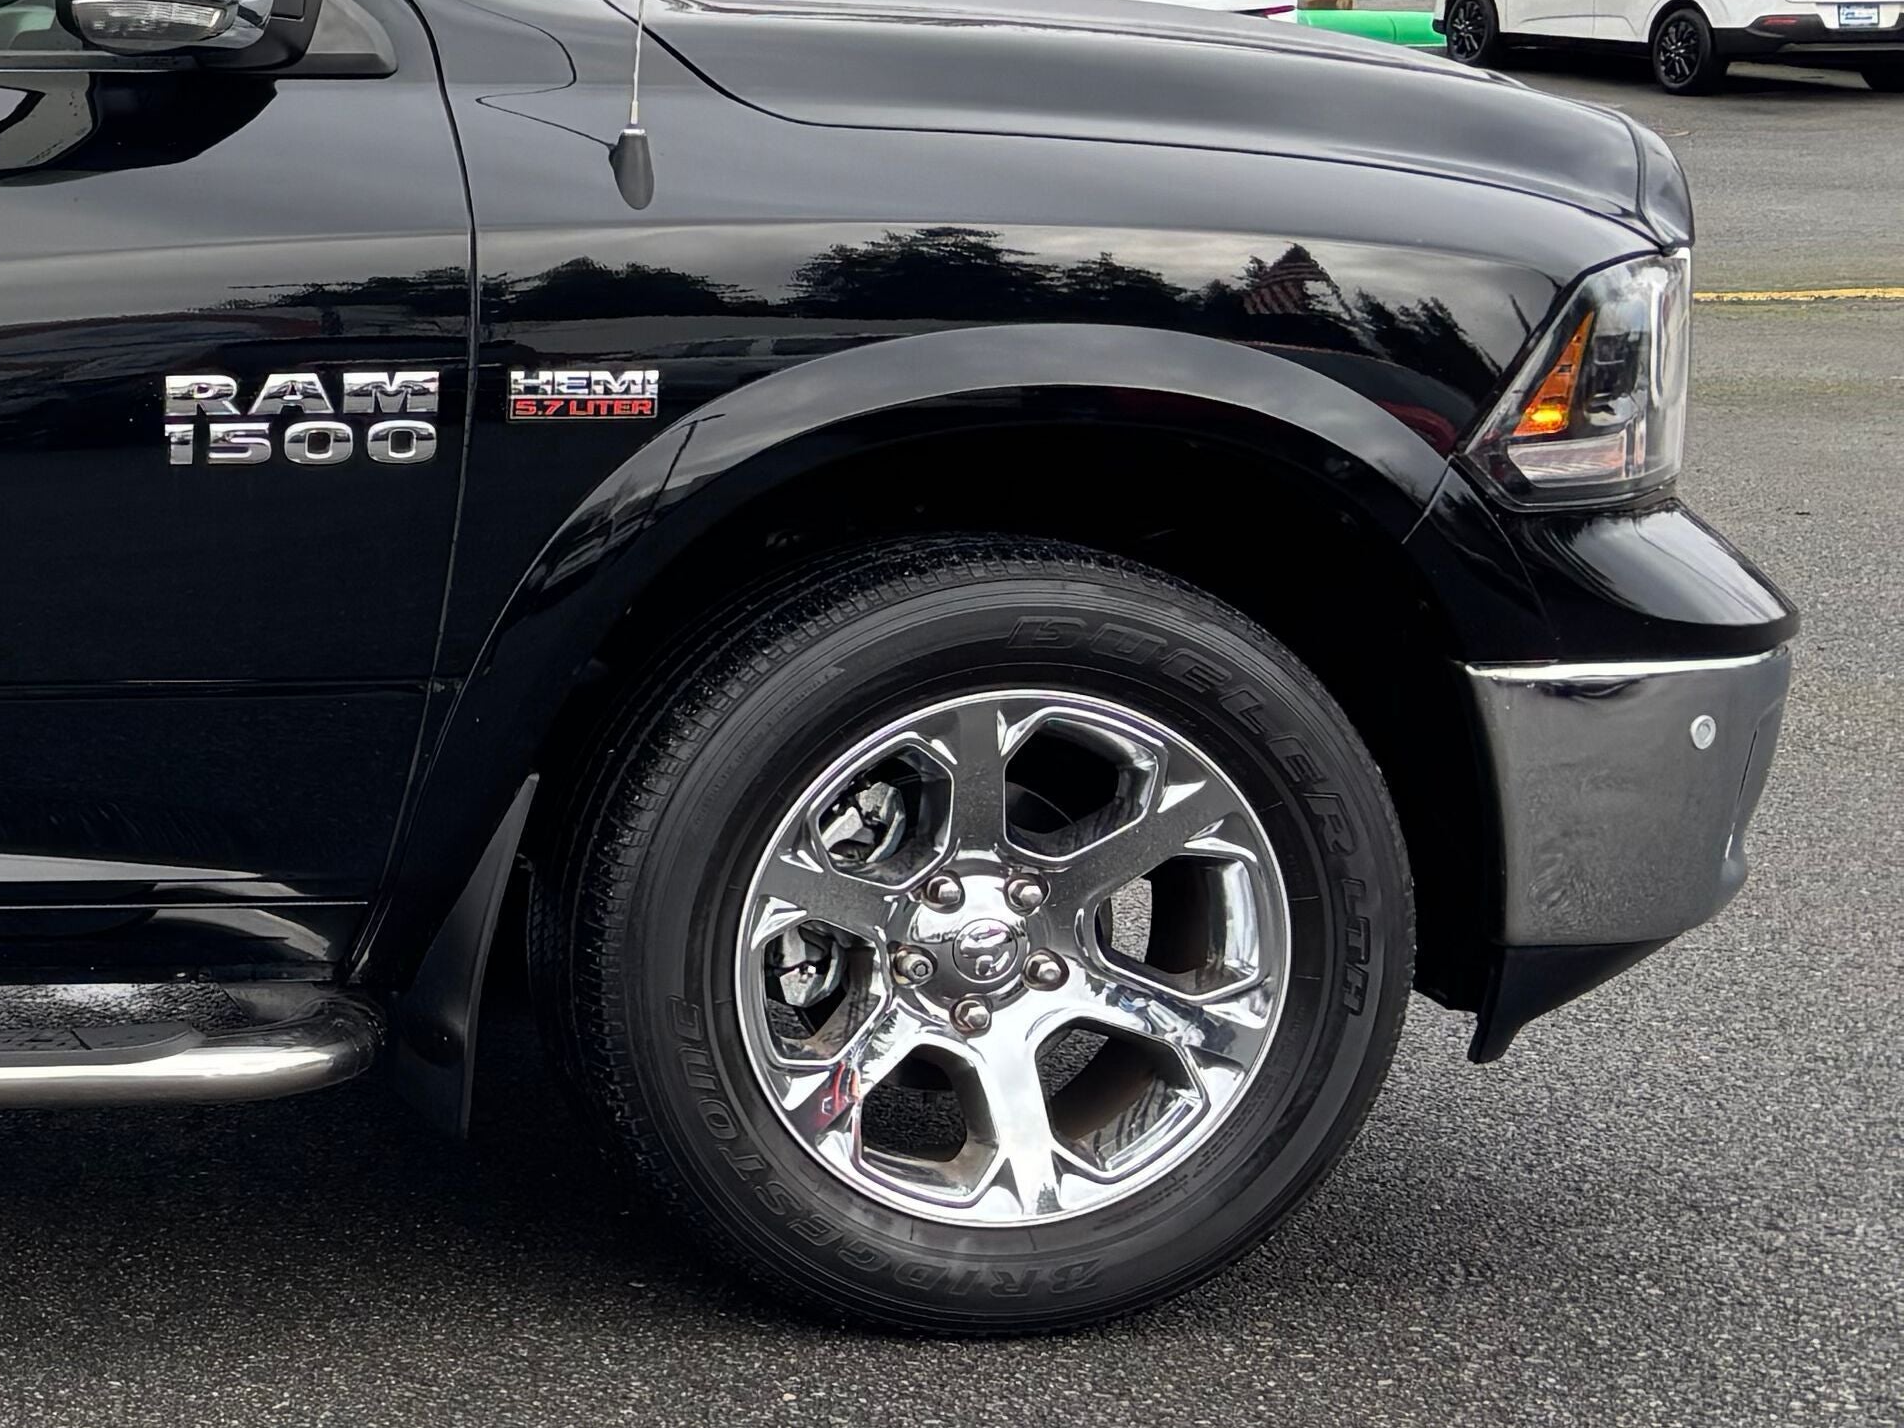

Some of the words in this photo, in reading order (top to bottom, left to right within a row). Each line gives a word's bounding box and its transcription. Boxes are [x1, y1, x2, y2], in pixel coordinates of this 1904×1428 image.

[164, 370, 440, 416] RAM
[508, 370, 659, 397] HEMI
[514, 398, 564, 417] 5.7
[568, 397, 654, 417] LITER
[164, 419, 438, 465] 1500
[672, 993, 1106, 1298] BRIDGESTONE
